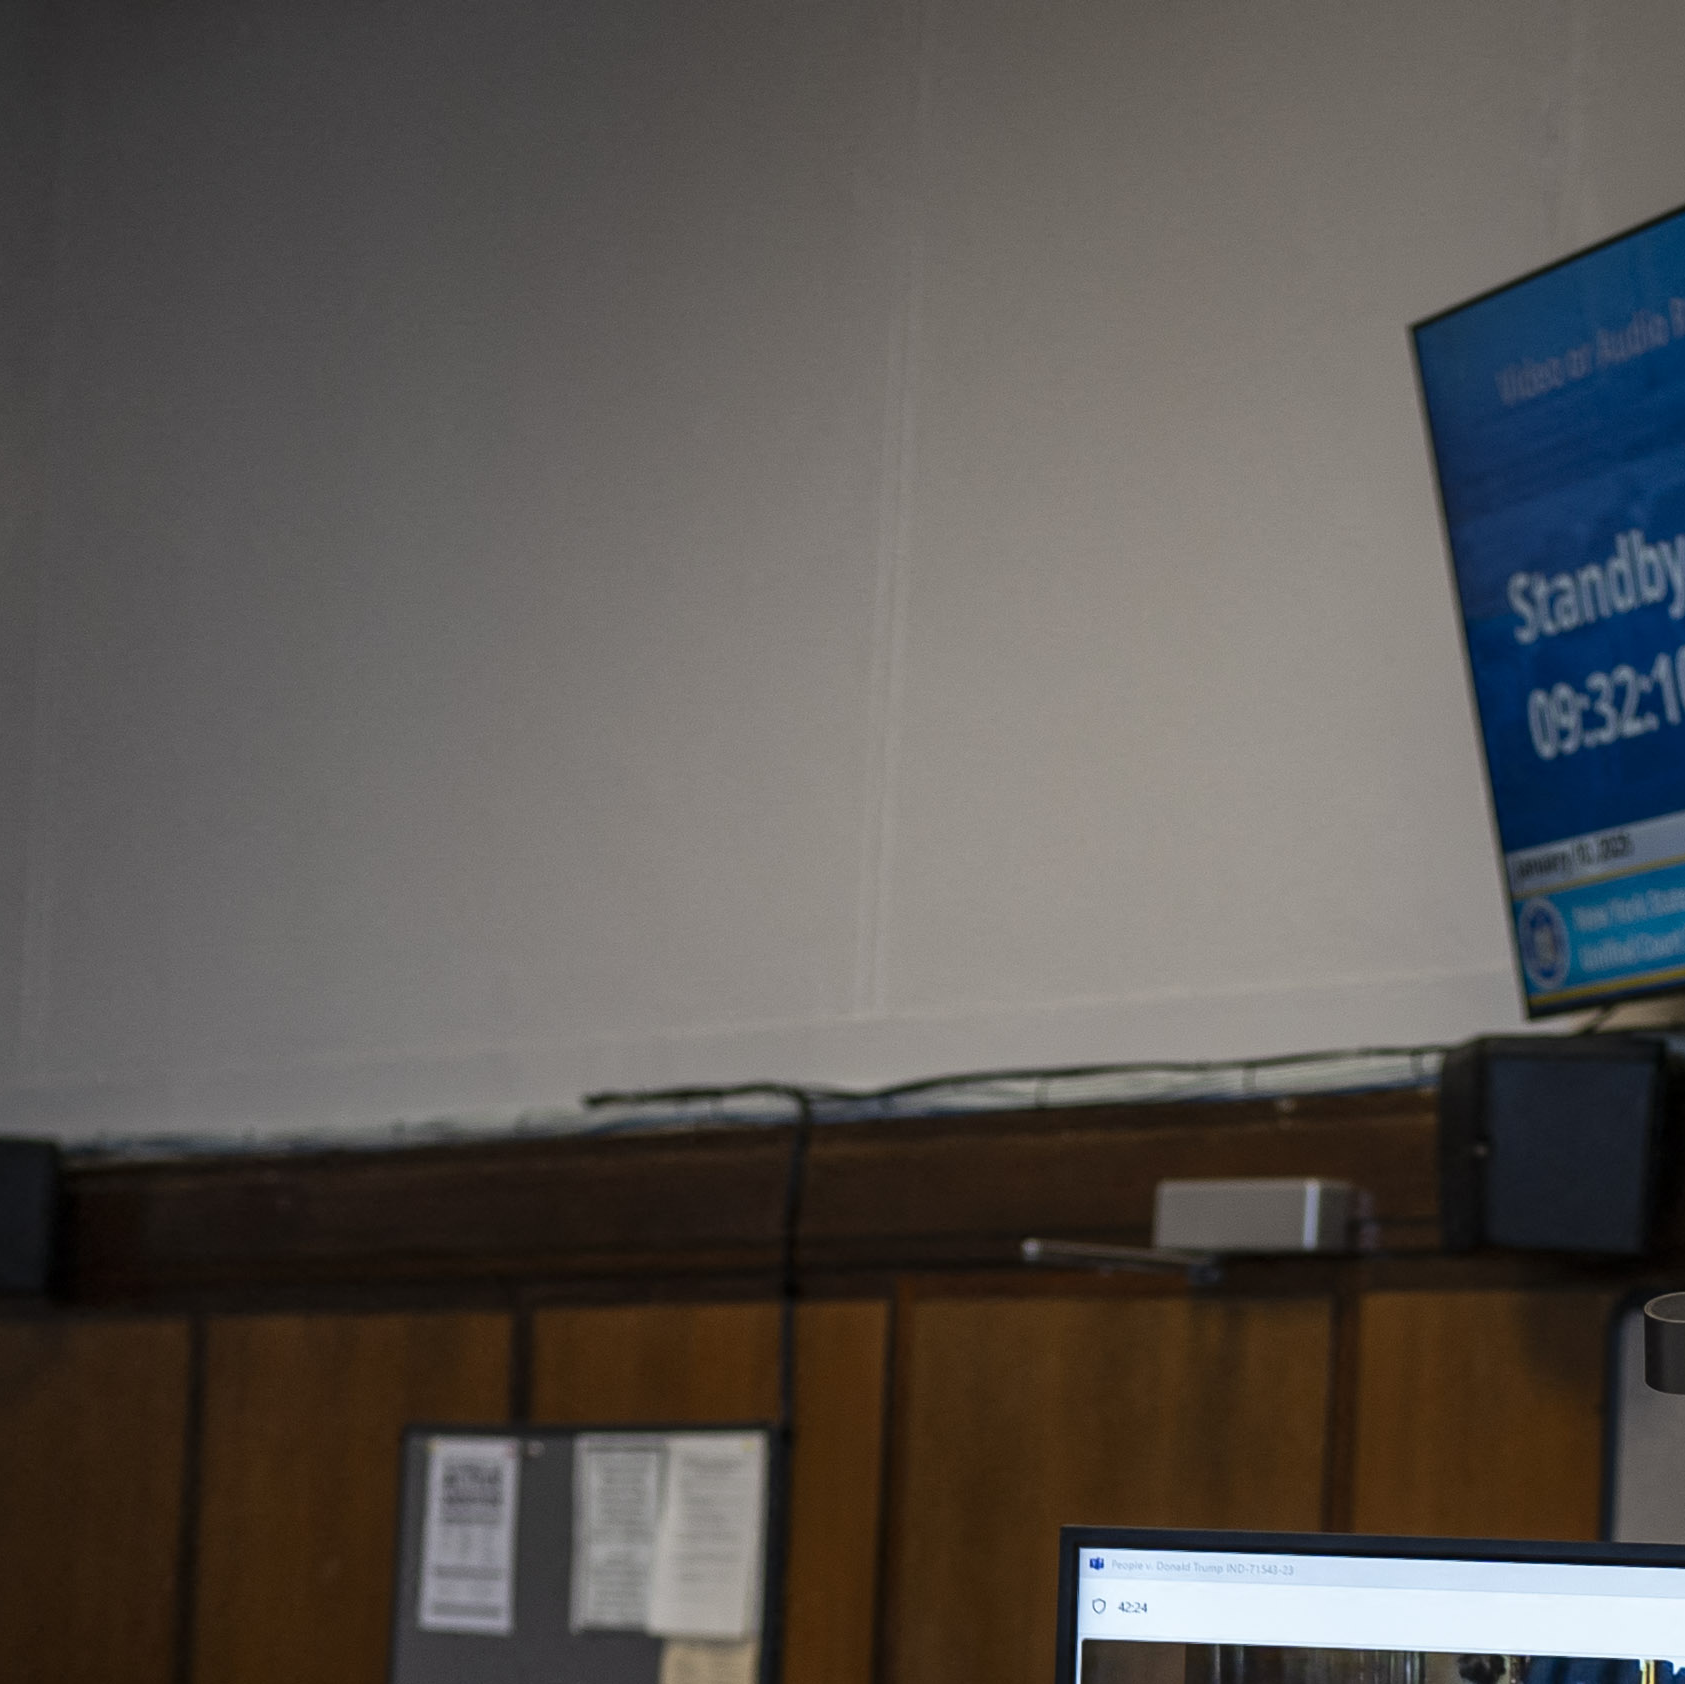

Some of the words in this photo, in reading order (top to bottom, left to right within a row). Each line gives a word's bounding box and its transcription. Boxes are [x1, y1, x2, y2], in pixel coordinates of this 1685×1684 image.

[1596, 309, 1670, 366] Audio
[1111, 1559, 1144, 1572] People
[1157, 1560, 1191, 1573] Donald
[1194, 1562, 1224, 1575] Trump
[1226, 1563, 1295, 1576] IND-71543-23
[1118, 1601, 1148, 1613] 42:24
